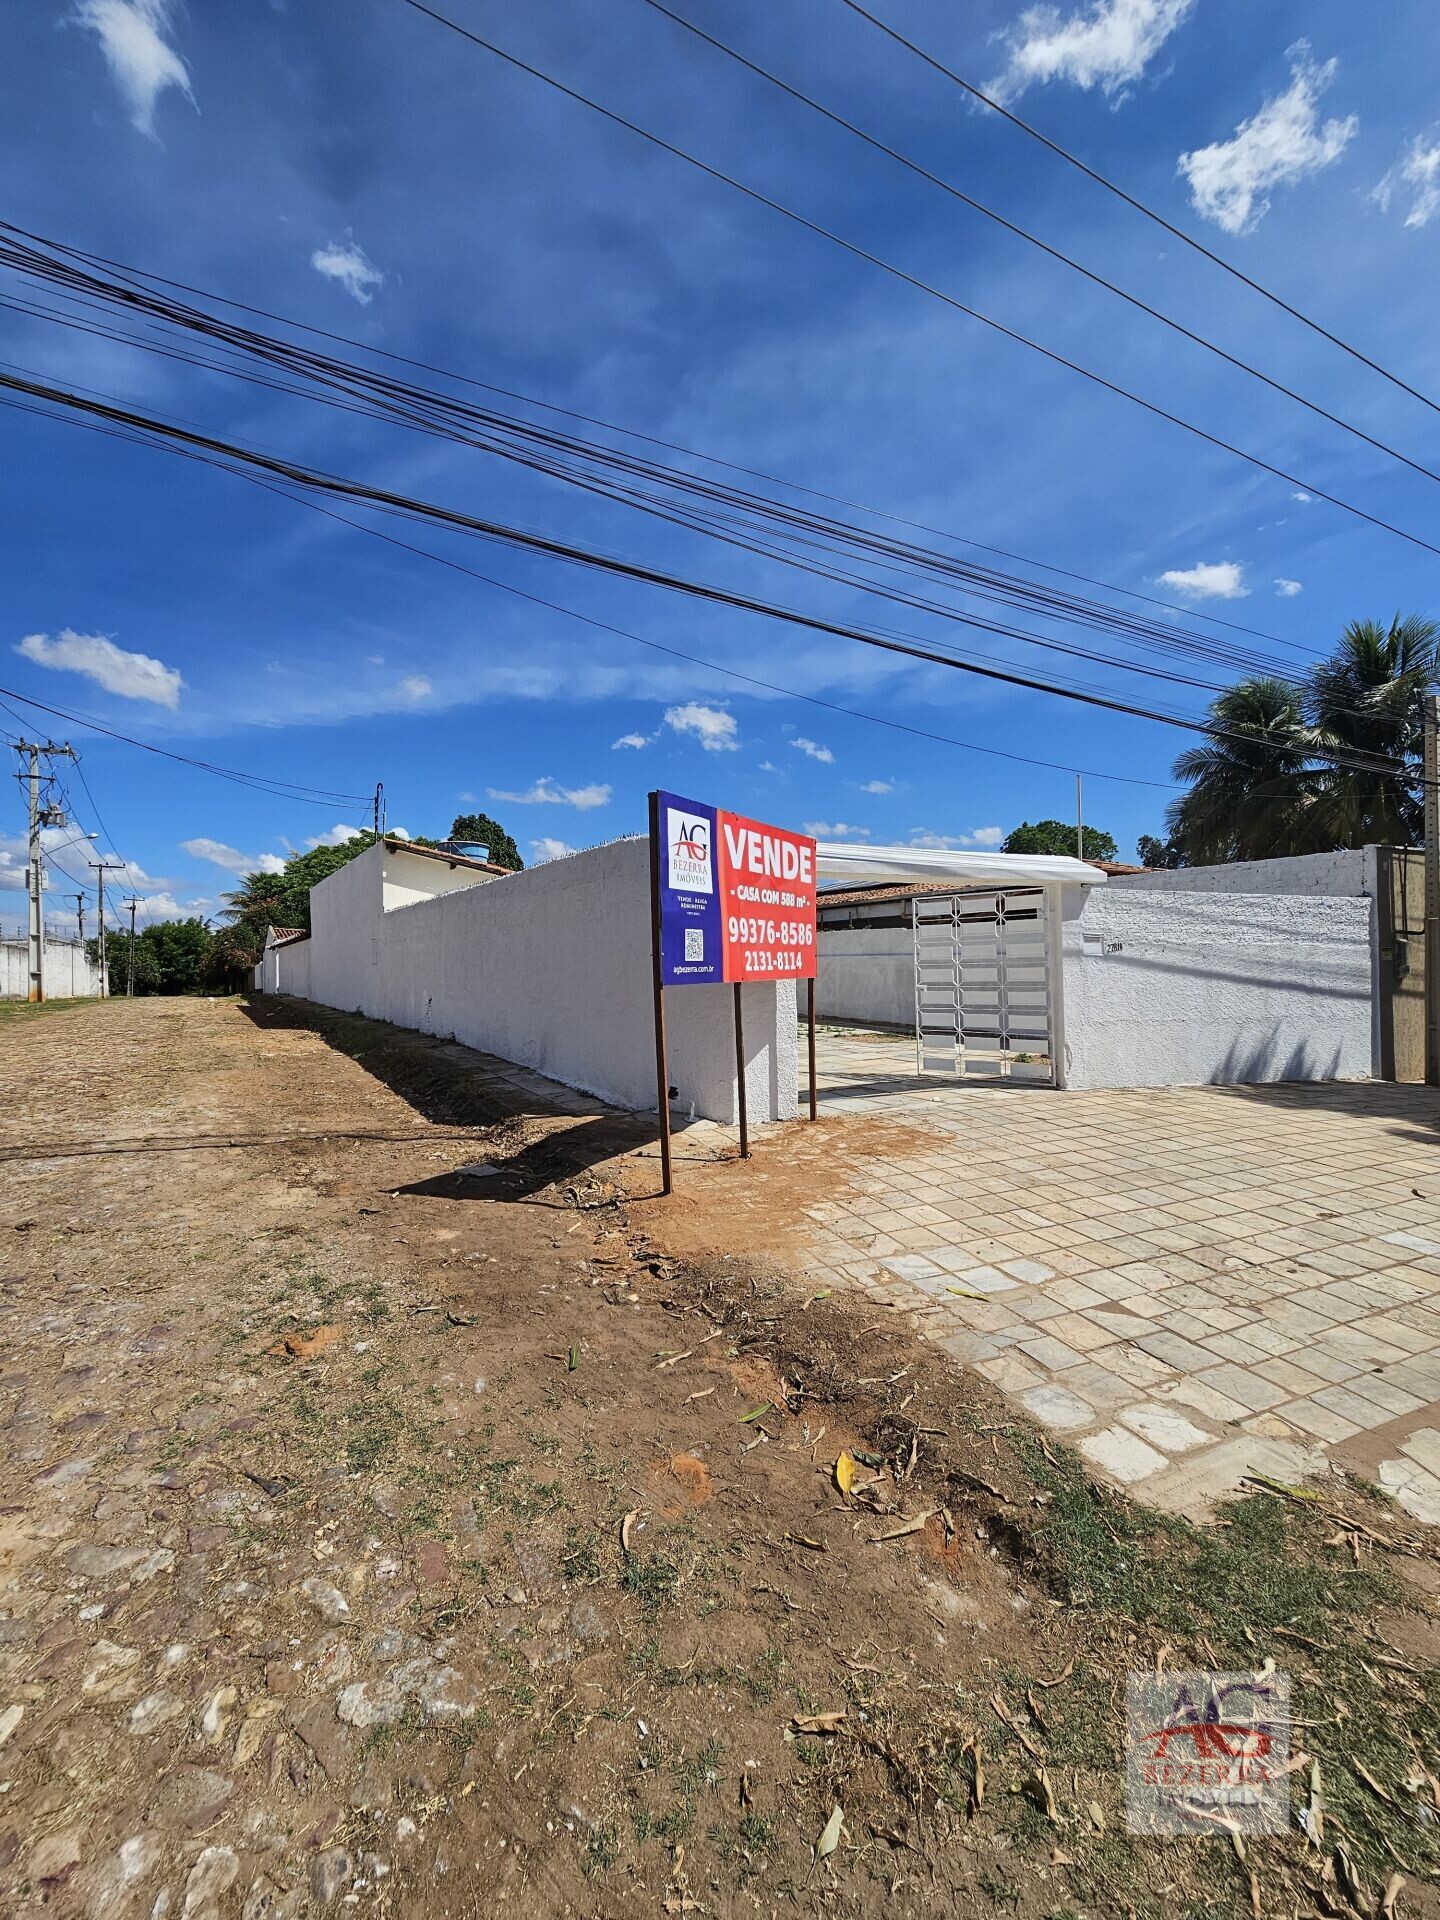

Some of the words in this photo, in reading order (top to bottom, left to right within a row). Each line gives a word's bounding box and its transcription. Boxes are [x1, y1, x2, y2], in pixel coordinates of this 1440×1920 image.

[673, 820, 709, 862] AG
[723, 823, 812, 884] VENDE
[673, 859, 708, 875] BEZERRA
[676, 871, 706, 886] IMÓVEIS
[737, 884, 761, 902] CASA
[761, 889, 780, 905] COM
[728, 916, 813, 945] 99376-8586
[673, 964, 714, 975] agbezerra.com.br
[744, 950, 803, 972] 2131-8114
